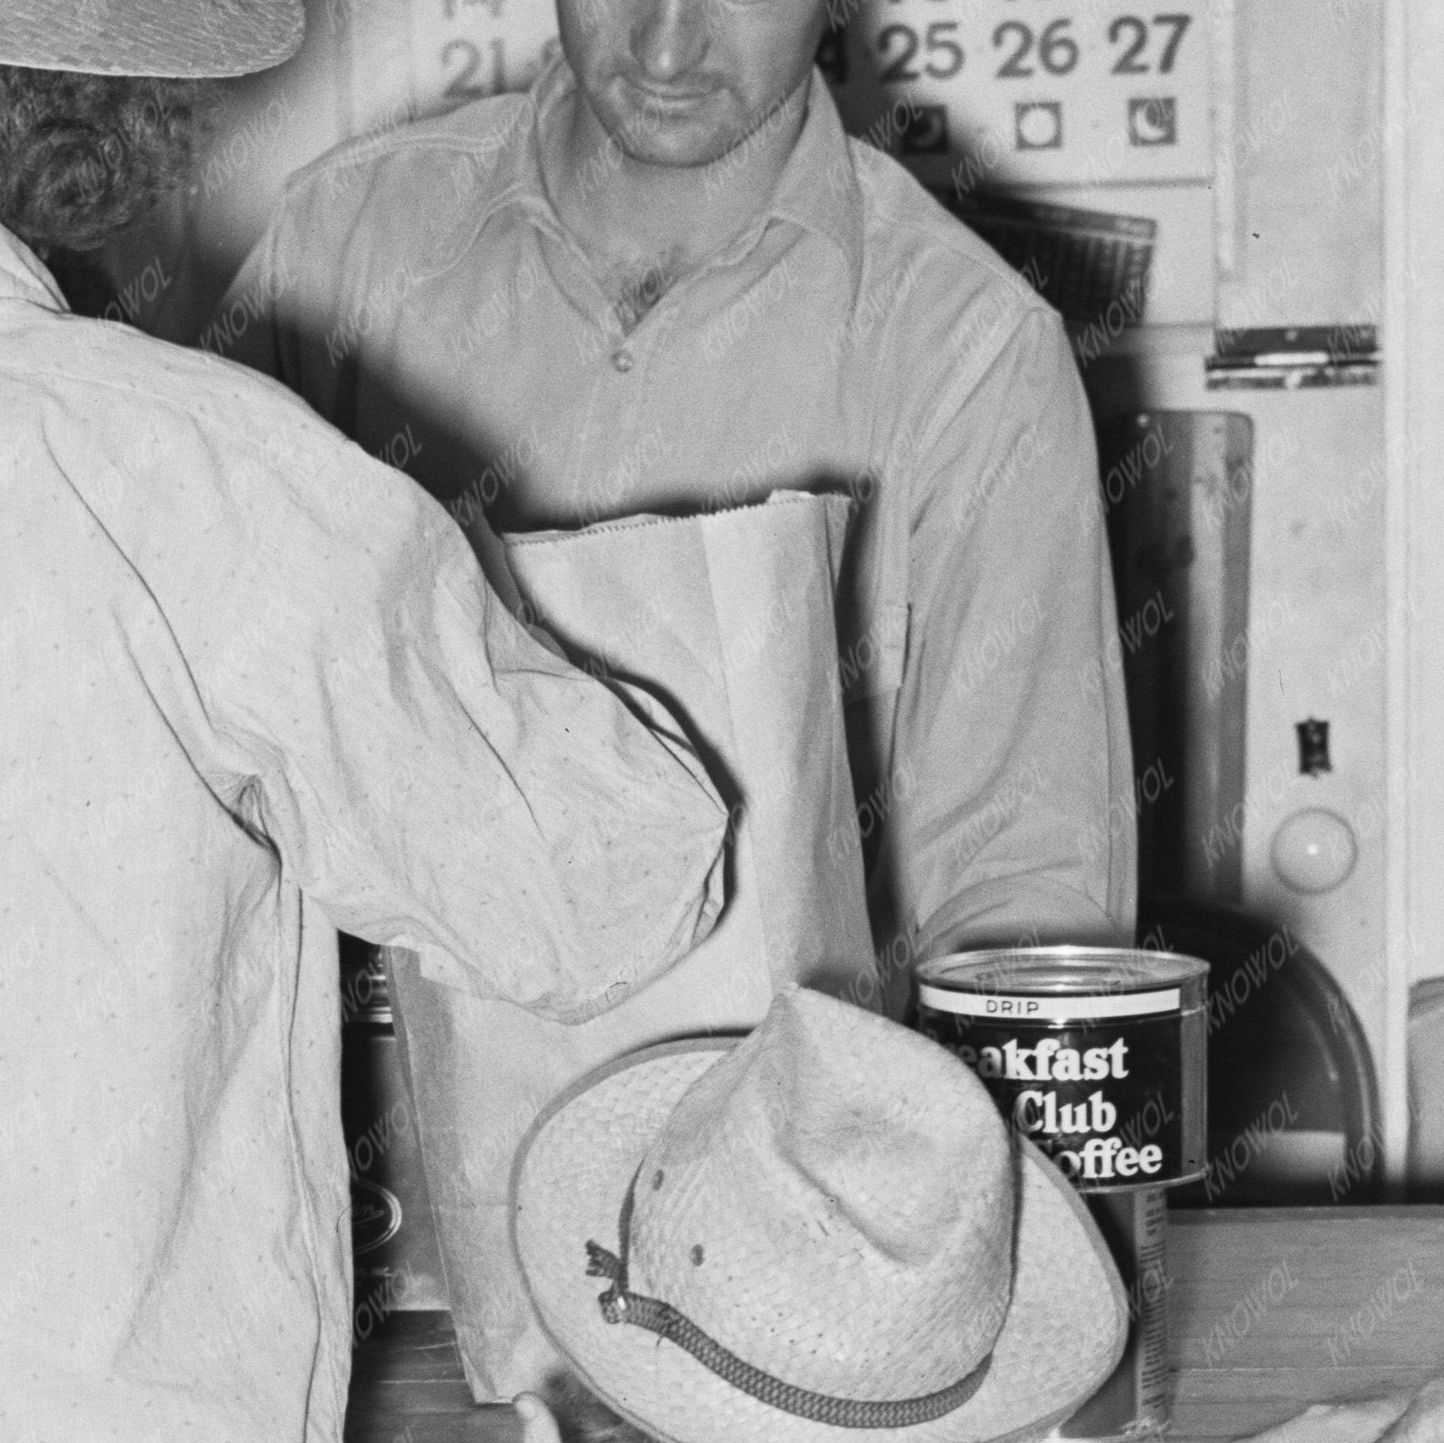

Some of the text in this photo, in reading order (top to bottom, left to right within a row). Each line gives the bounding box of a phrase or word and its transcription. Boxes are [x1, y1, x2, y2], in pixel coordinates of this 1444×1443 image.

[877, 21, 966, 83] 25
[992, 17, 1080, 80] 26
[1107, 13, 1192, 76] 27
[985, 999, 1040, 1014] DRIP
[947, 1037, 1130, 1082] eakfast
[1013, 1090, 1118, 1136] Club
[1045, 1137, 1164, 1180] offee
